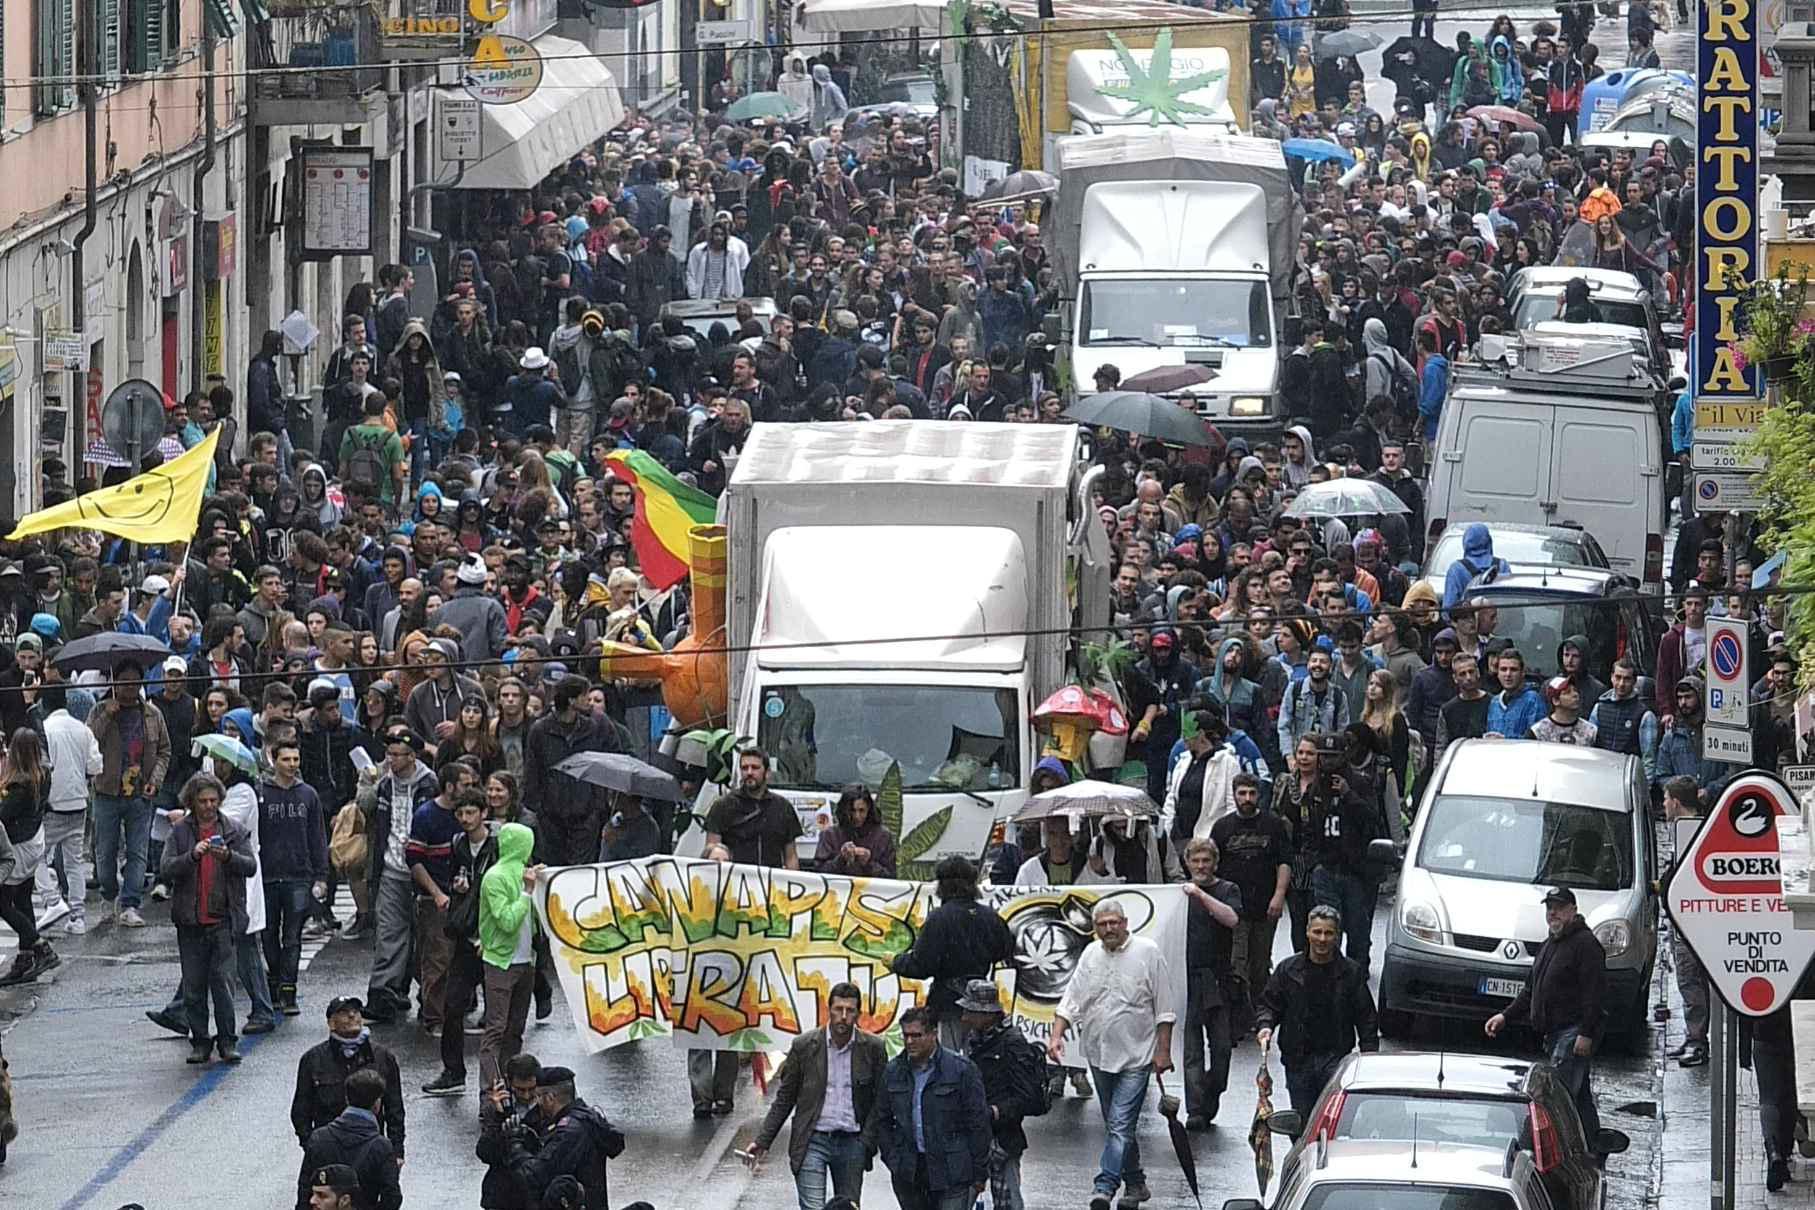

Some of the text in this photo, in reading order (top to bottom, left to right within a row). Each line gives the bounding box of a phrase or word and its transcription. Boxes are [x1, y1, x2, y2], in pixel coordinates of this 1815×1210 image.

[1707, 737, 1749, 753] 30 minuti
[1680, 899, 1792, 913] PITTURE E VE
[1728, 931, 1781, 946] PUNTO
[1748, 946, 1762, 959] DI
[1723, 959, 1788, 973] VENDITA
